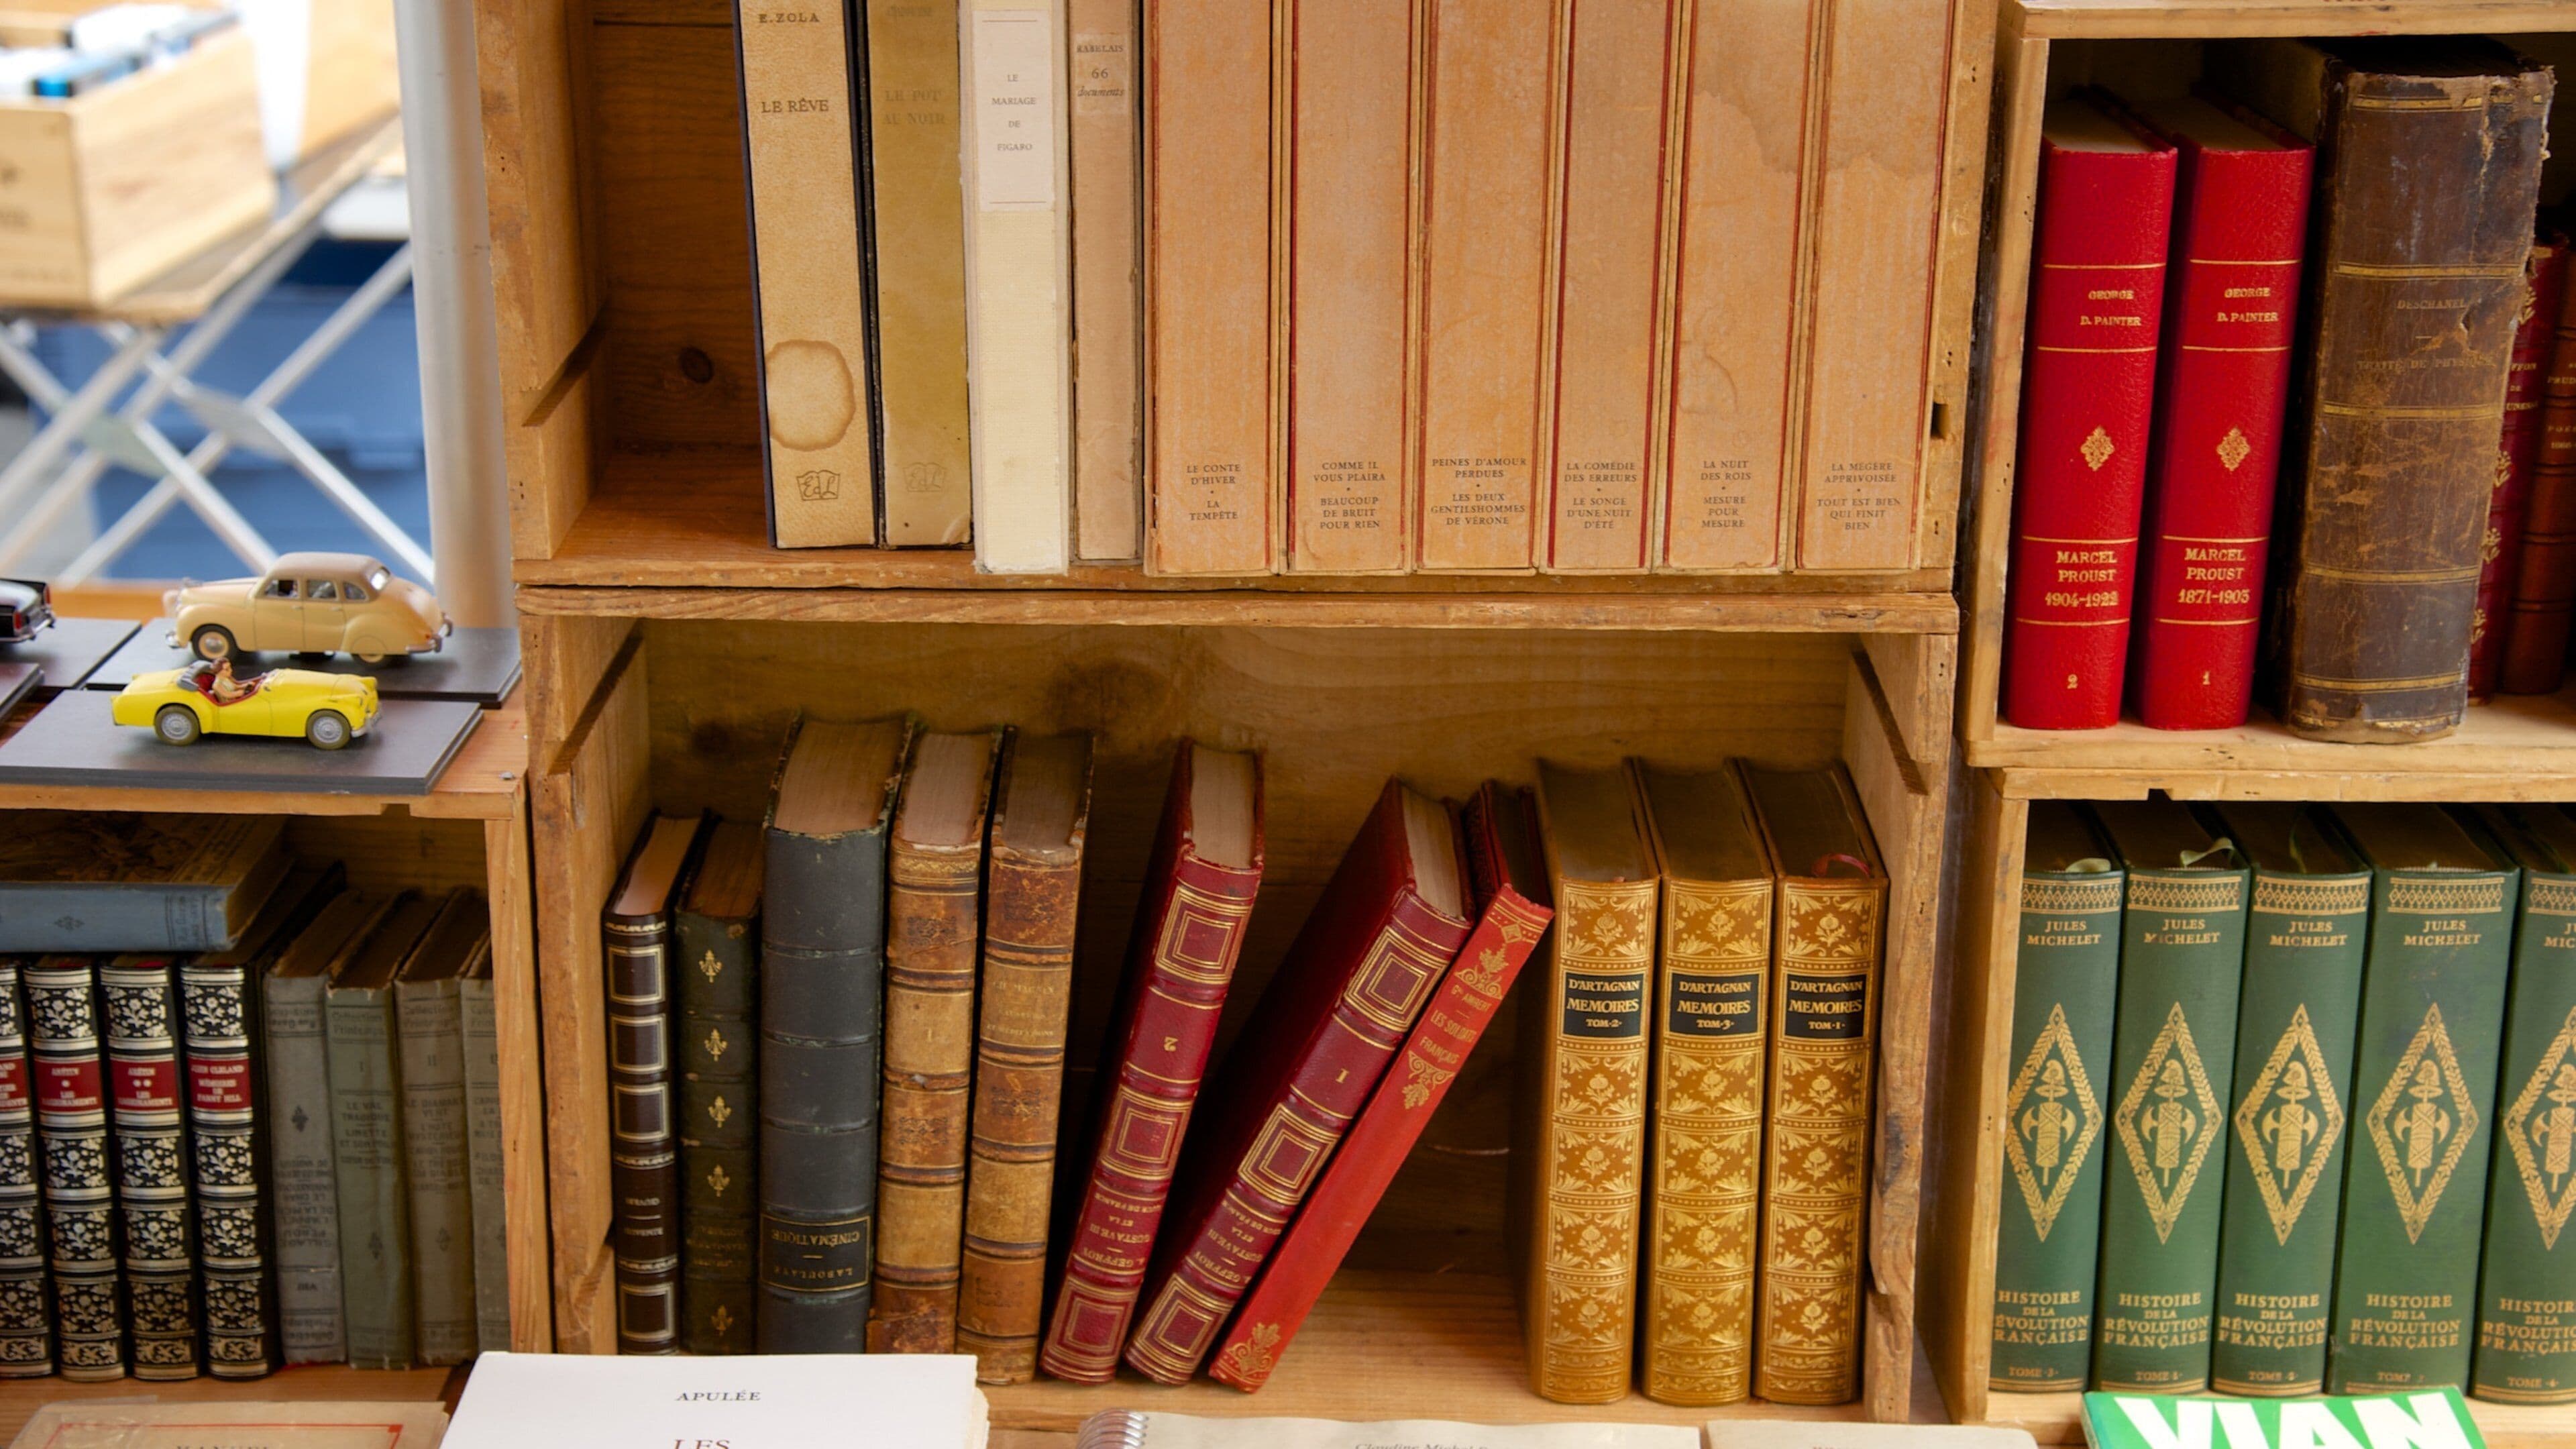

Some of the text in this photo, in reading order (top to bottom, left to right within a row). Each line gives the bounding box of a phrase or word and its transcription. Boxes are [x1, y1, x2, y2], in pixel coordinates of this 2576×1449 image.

[1091, 67, 1108, 78] 66
[762, 97, 829, 113] LE RÊVE
[992, 97, 1036, 105] MARIAGE
[997, 143, 1032, 151] FIGARO
[2089, 290, 2134, 300] GEORGE
[2225, 288, 2270, 298] GEORGE
[2397, 300, 2467, 309] DESCHANEL
[2080, 316, 2141, 326] D. PAINTER
[2217, 312, 2279, 322] D. PAINTER
[1203, 464, 1240, 472] CONTE
[1455, 470, 1503, 478] PERDUES
[1191, 476, 1236, 485] D'HIVER
[1313, 473, 1385, 482] VOUS PLAIRA
[1725, 472, 1751, 480] ROIS
[1320, 497, 1378, 506] BEAUCOUP
[1476, 493, 1505, 501] DEUX
[1817, 498, 1847, 506] TOUT
[1343, 508, 1375, 517] BRUIT
[1431, 505, 1525, 513] GENTILSHOMMES
[1567, 509, 1631, 517] D'UNE NUIT
[1830, 510, 1885, 519] QUI FINIT
[1189, 510, 1238, 521] TEMPÊTE
[1446, 517, 1460, 525] DE
[1320, 520, 1380, 529] POUR RIEN
[1584, 519, 1613, 529] D'ÉTÉ
[1845, 522, 1870, 530] BIEN
[2056, 551, 2117, 564] MARCEL
[2185, 548, 2246, 561] MARCEL
[2058, 570, 2116, 582] PROUST
[2186, 568, 2244, 580] PROUST
[2179, 590, 2250, 604] 1871-1905
[2068, 674, 2078, 688] 2
[2202, 672, 2210, 685] 1
[2045, 921, 2086, 932] JULES
[2163, 919, 2206, 930] JULES
[2289, 921, 2332, 933] JULES
[2422, 920, 2466, 932] JULES
[2027, 934, 2101, 945] MICHELET
[2269, 934, 2347, 946] MICHELET
[2404, 934, 2481, 945] MICHELET
[1568, 979, 1640, 993] D'ARTAGNAN
[1679, 981, 1751, 994] D'ARTAGNAN
[1790, 981, 1862, 993] D'ARTAGNAN
[1462, 993, 1492, 1012] AMBERT
[1567, 998, 1640, 1013] MEMOIRES
[1677, 1000, 1751, 1014] MEMOIRES
[1788, 1000, 1862, 1014] MEMOIRES
[1430, 1010, 1447, 1027] LES
[1164, 1036, 1178, 1051] 2
[1419, 1036, 1460, 1064] FRANÇAIS
[1336, 1069, 1348, 1083] 1
[1095, 1193, 1139, 1212] DE FRANCE
[1109, 1216, 1120, 1224] LA
[1251, 1220, 1263, 1230] DE
[772, 1230, 860, 1248] CINÉMATIQUE
[1101, 1229, 1150, 1243] GUSTAVE
[1232, 1226, 1254, 1242] ET LA
[1208, 1229, 1263, 1262] GUSTAVE III
[1083, 1248, 1133, 1267] GEFFROY
[1195, 1251, 1240, 1283] GEFFROY
[1998, 1291, 2080, 1305] HISTOIRE
[2119, 1293, 2201, 1308] HISTOIRE
[2235, 1293, 2319, 1309] HISTOIRE
[2367, 1294, 2453, 1307] HISTOIRE
[2023, 1307, 2055, 1316] DE LA
[2500, 1298, 2576, 1313] HISTOIR
[2144, 1309, 2177, 1318] DE LA
[2260, 1310, 2294, 1320] DE LA
[2392, 1310, 2426, 1320] DE LA
[1996, 1315, 2090, 1330] ÉVOLUTION
[2105, 1316, 2208, 1332] RÉVOLUTION
[2220, 1316, 2327, 1334] RÉVOLUTION
[2351, 1318, 2461, 1333] RÉVOLUTION
[2525, 1316, 2559, 1325] DE LA
[1995, 1330, 2088, 1345] RANÇAISE
[2104, 1330, 2208, 1349] FRANÇAISE
[2218, 1329, 2326, 1350] FRANÇAISE
[2349, 1333, 2459, 1350] FRANÇAISE
[2481, 1336, 2576, 1355] FRANÇAIS
[2009, 1367, 2042, 1377] TOME
[2136, 1371, 2169, 1381] TOME
[2508, 1377, 2542, 1387] TOME
[676, 1390, 761, 1401] APULÉE
[2114, 1392, 2472, 1449] VIAN
